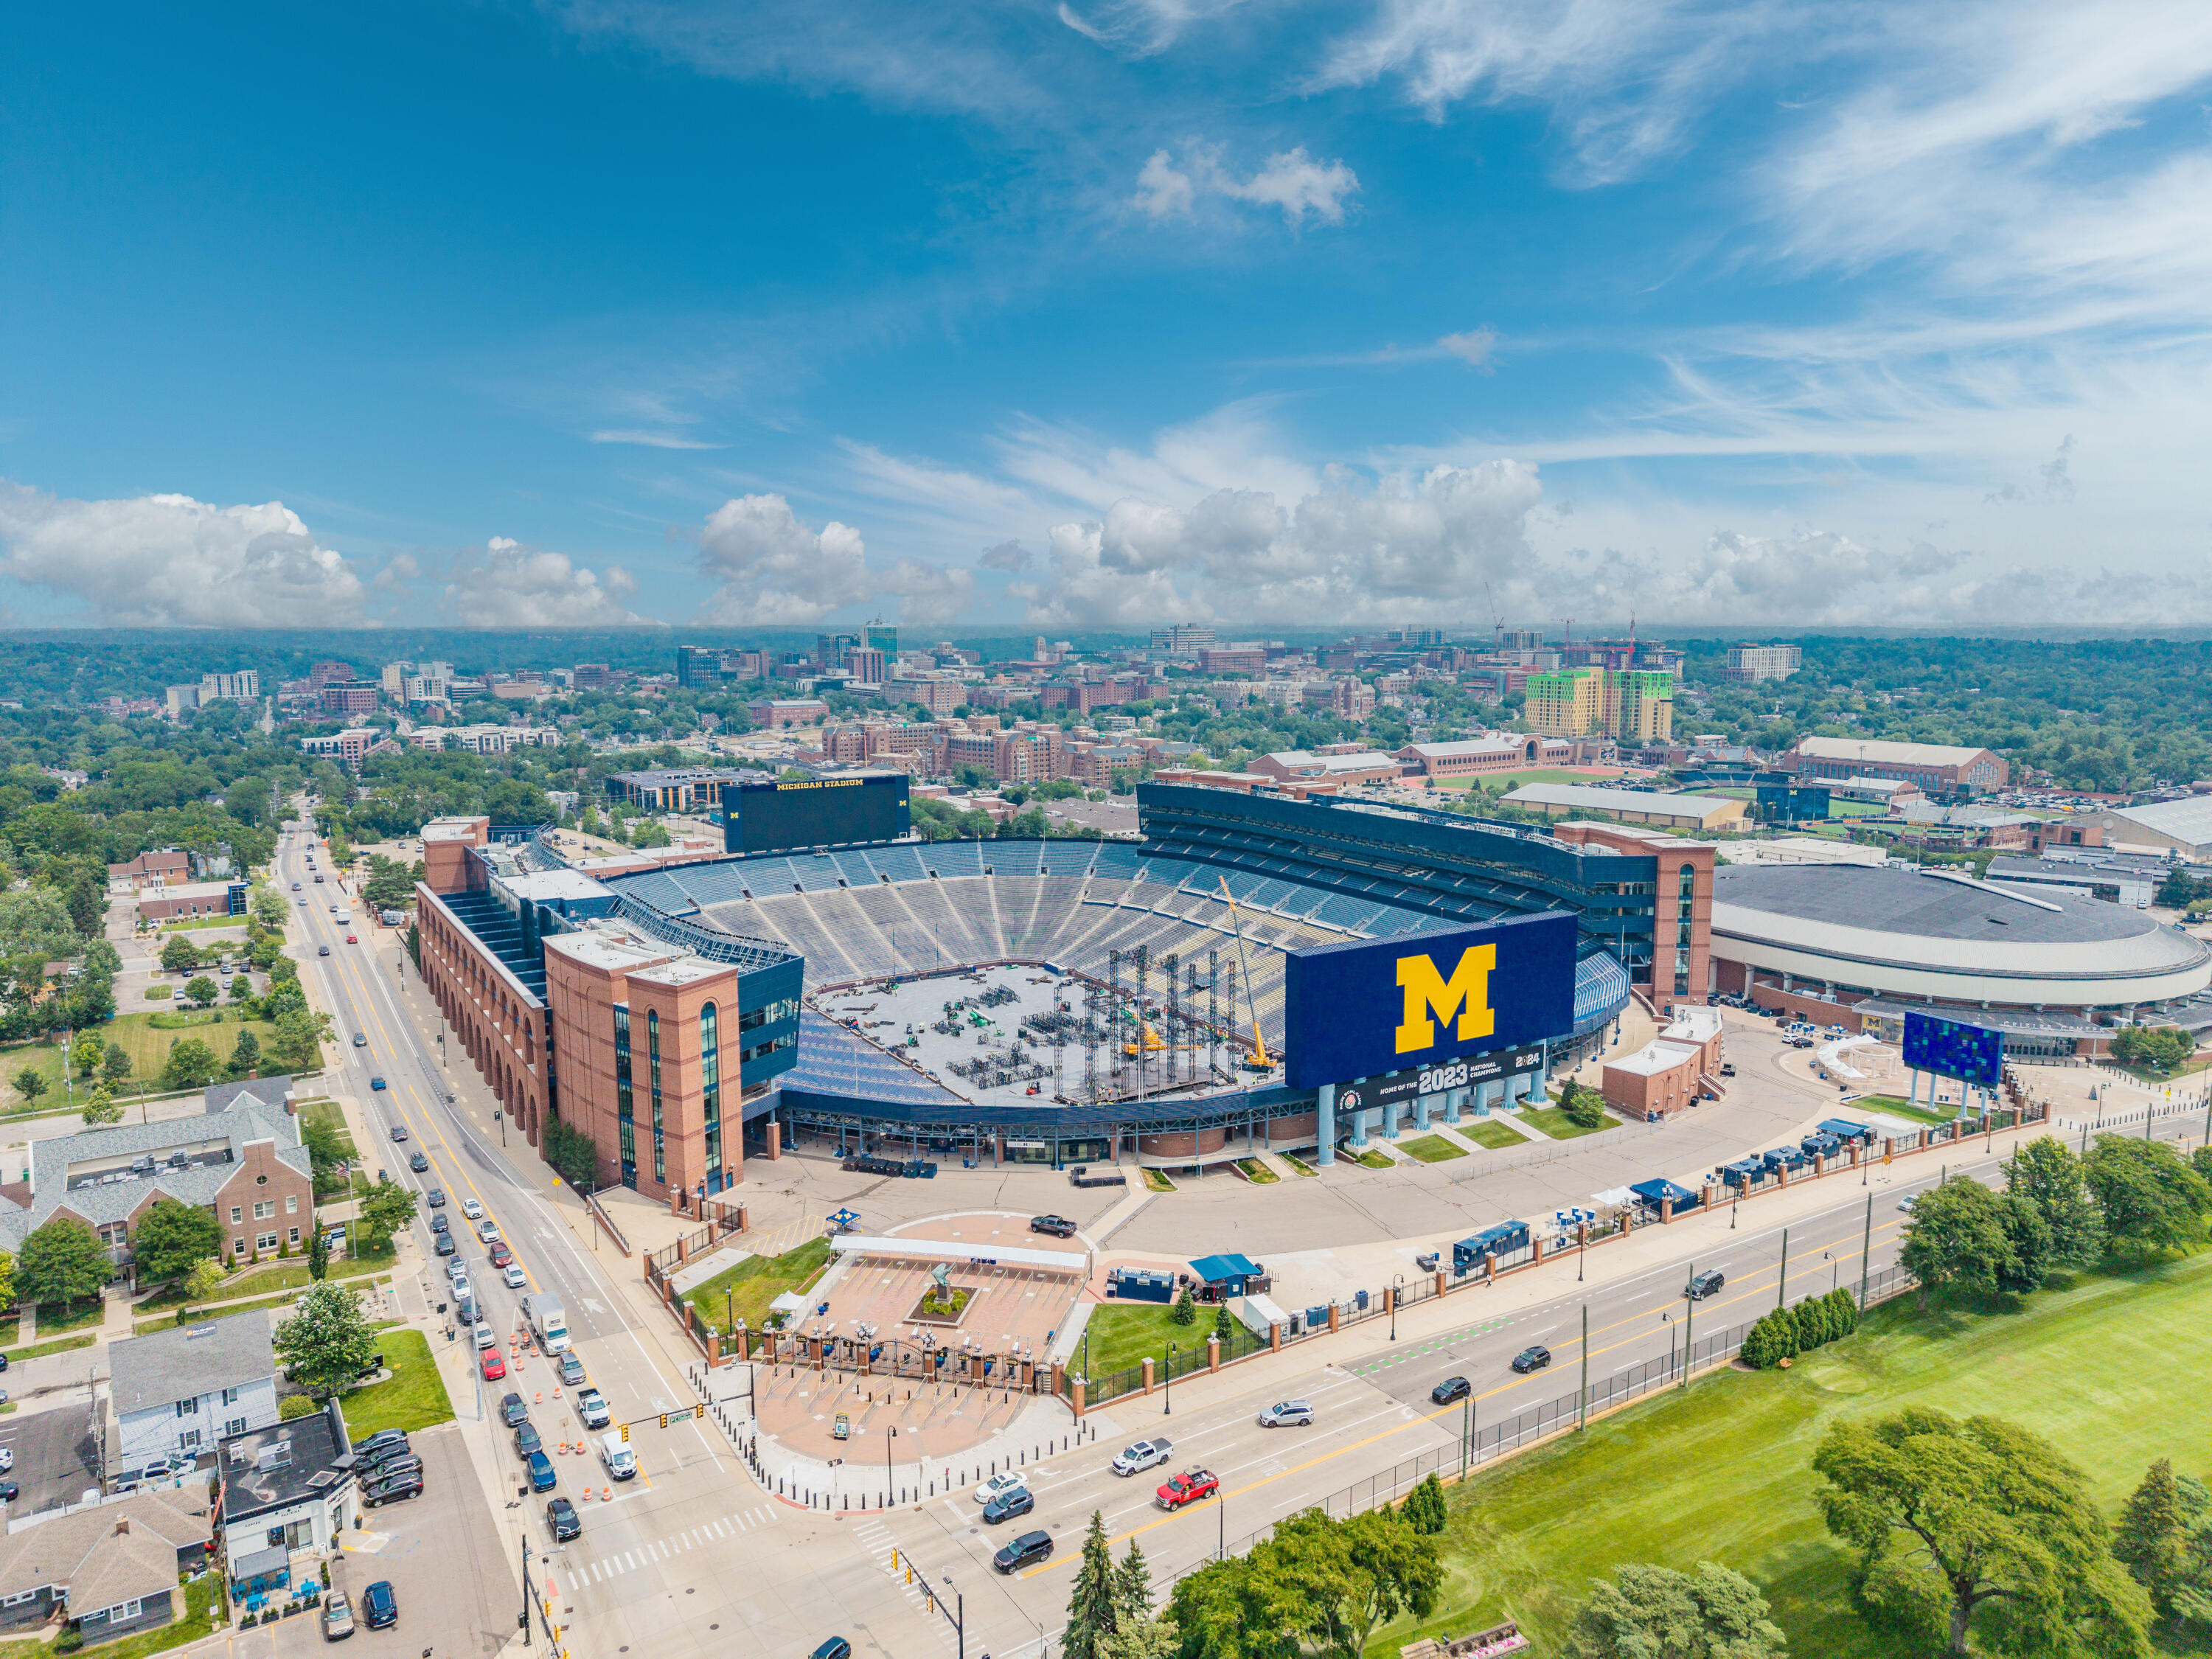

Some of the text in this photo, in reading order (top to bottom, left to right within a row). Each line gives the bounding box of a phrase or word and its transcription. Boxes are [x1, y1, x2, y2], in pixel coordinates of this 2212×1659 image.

[777, 779, 863, 790] MICHIGAN STADIUM
[1395, 943, 1496, 1054] M
[1868, 1018, 1881, 1028] M
[1516, 1052, 1540, 1068] 2024
[1470, 1062, 1497, 1072] NATIONAL
[1470, 1066, 1502, 1078] CHAMPIONS
[1380, 1085, 1398, 1095] HOME
[1406, 1081, 1418, 1089] THE
[1419, 1064, 1468, 1094] 2023
